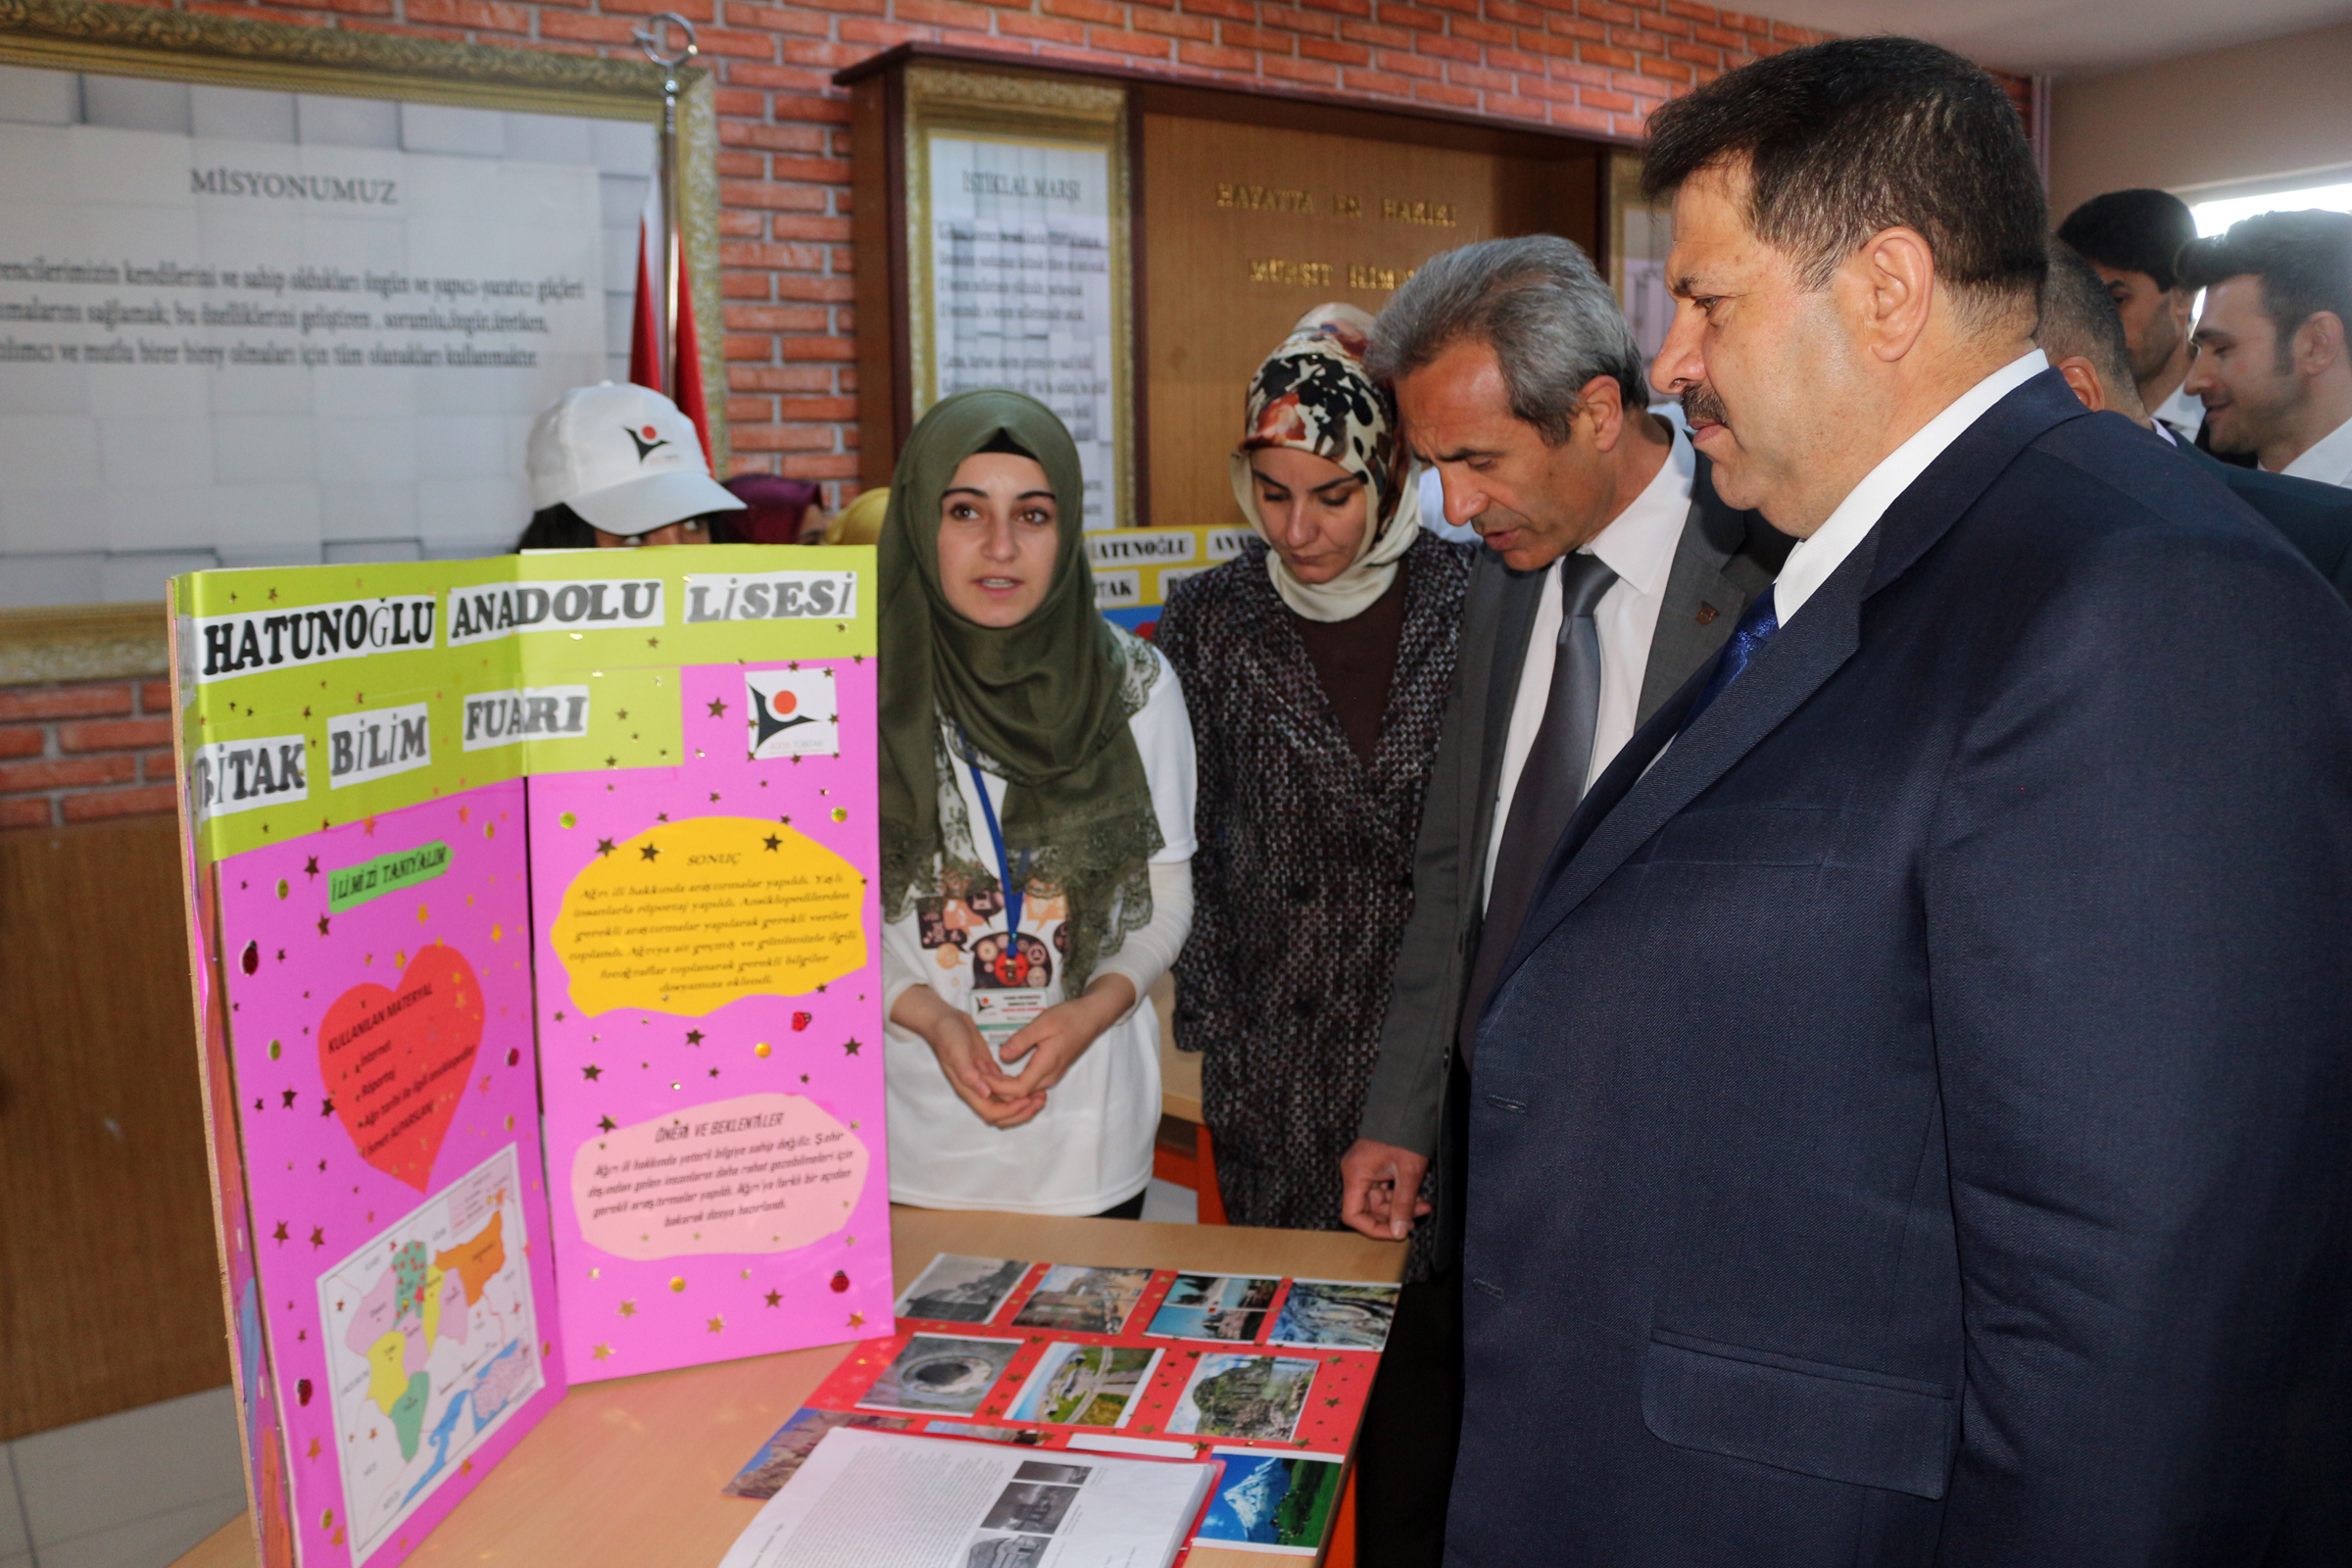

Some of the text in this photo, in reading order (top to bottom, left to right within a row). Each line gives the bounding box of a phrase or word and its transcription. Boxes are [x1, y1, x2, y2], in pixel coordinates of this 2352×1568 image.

[190, 166, 399, 204] MİSYONUMUZ
[1217, 183, 1314, 214] HAYATTA
[203, 572, 854, 675] HATUNOĞLU ANADOLU LİSESİ
[331, 712, 427, 776] BİLİM
[466, 695, 587, 742] FUARI
[686, 853, 742, 866] SONUÇ
